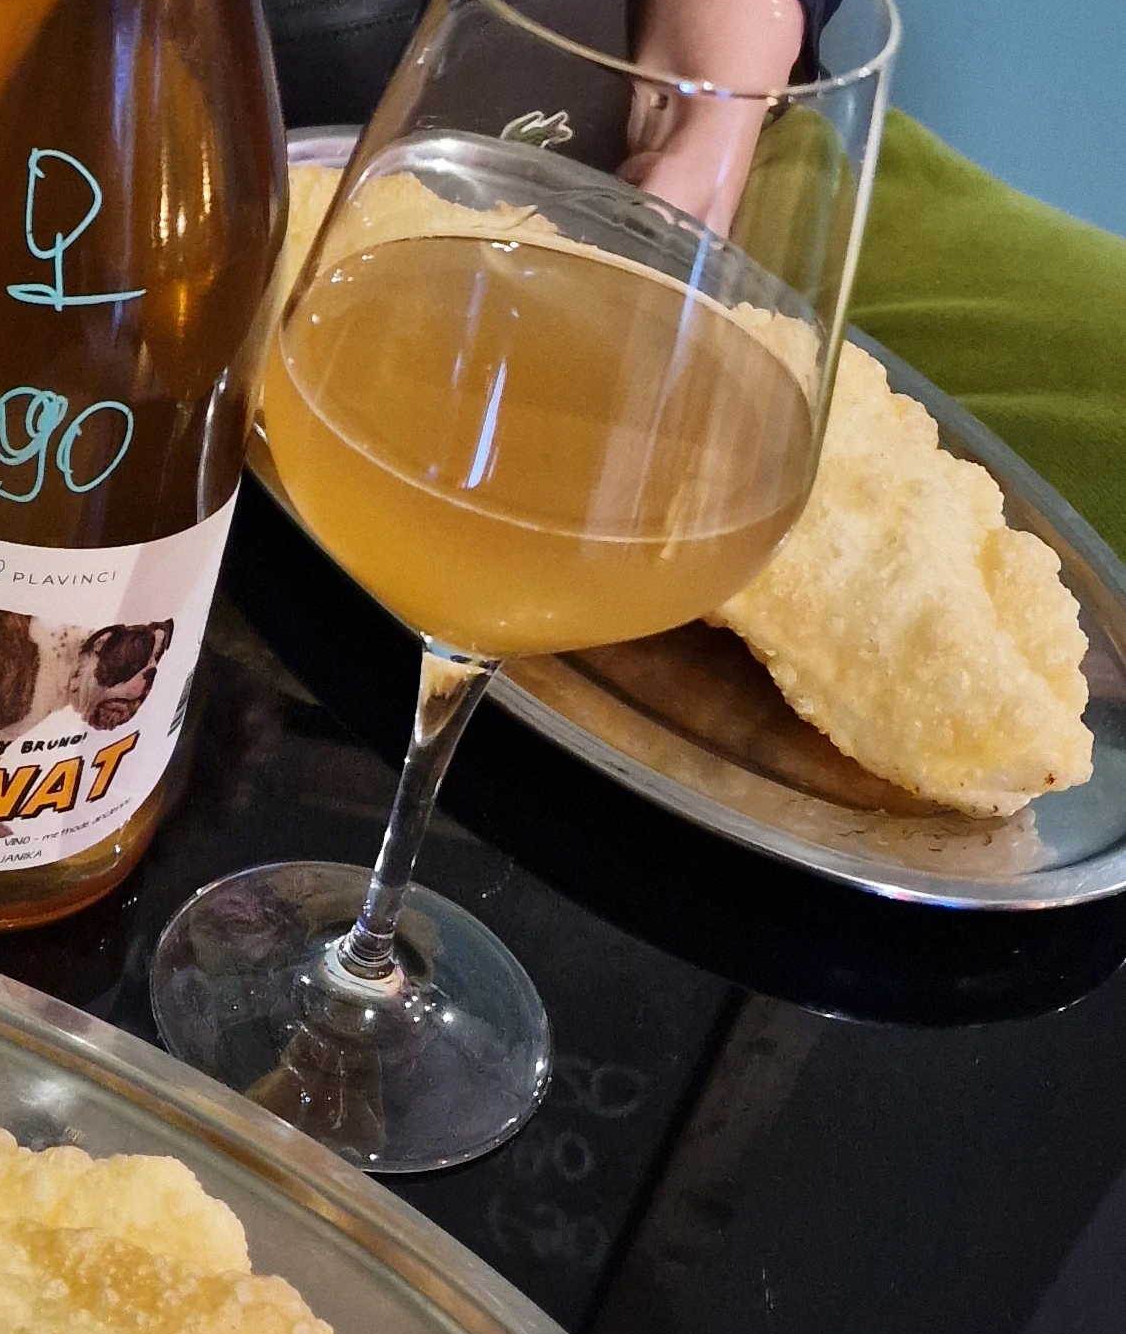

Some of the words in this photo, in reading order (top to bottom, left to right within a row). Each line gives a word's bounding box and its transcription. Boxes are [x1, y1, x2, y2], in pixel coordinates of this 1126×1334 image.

[12, 570, 116, 586] PLAVINCI
[20, 731, 87, 754] BRUNO!
[4, 834, 31, 847] VINO
